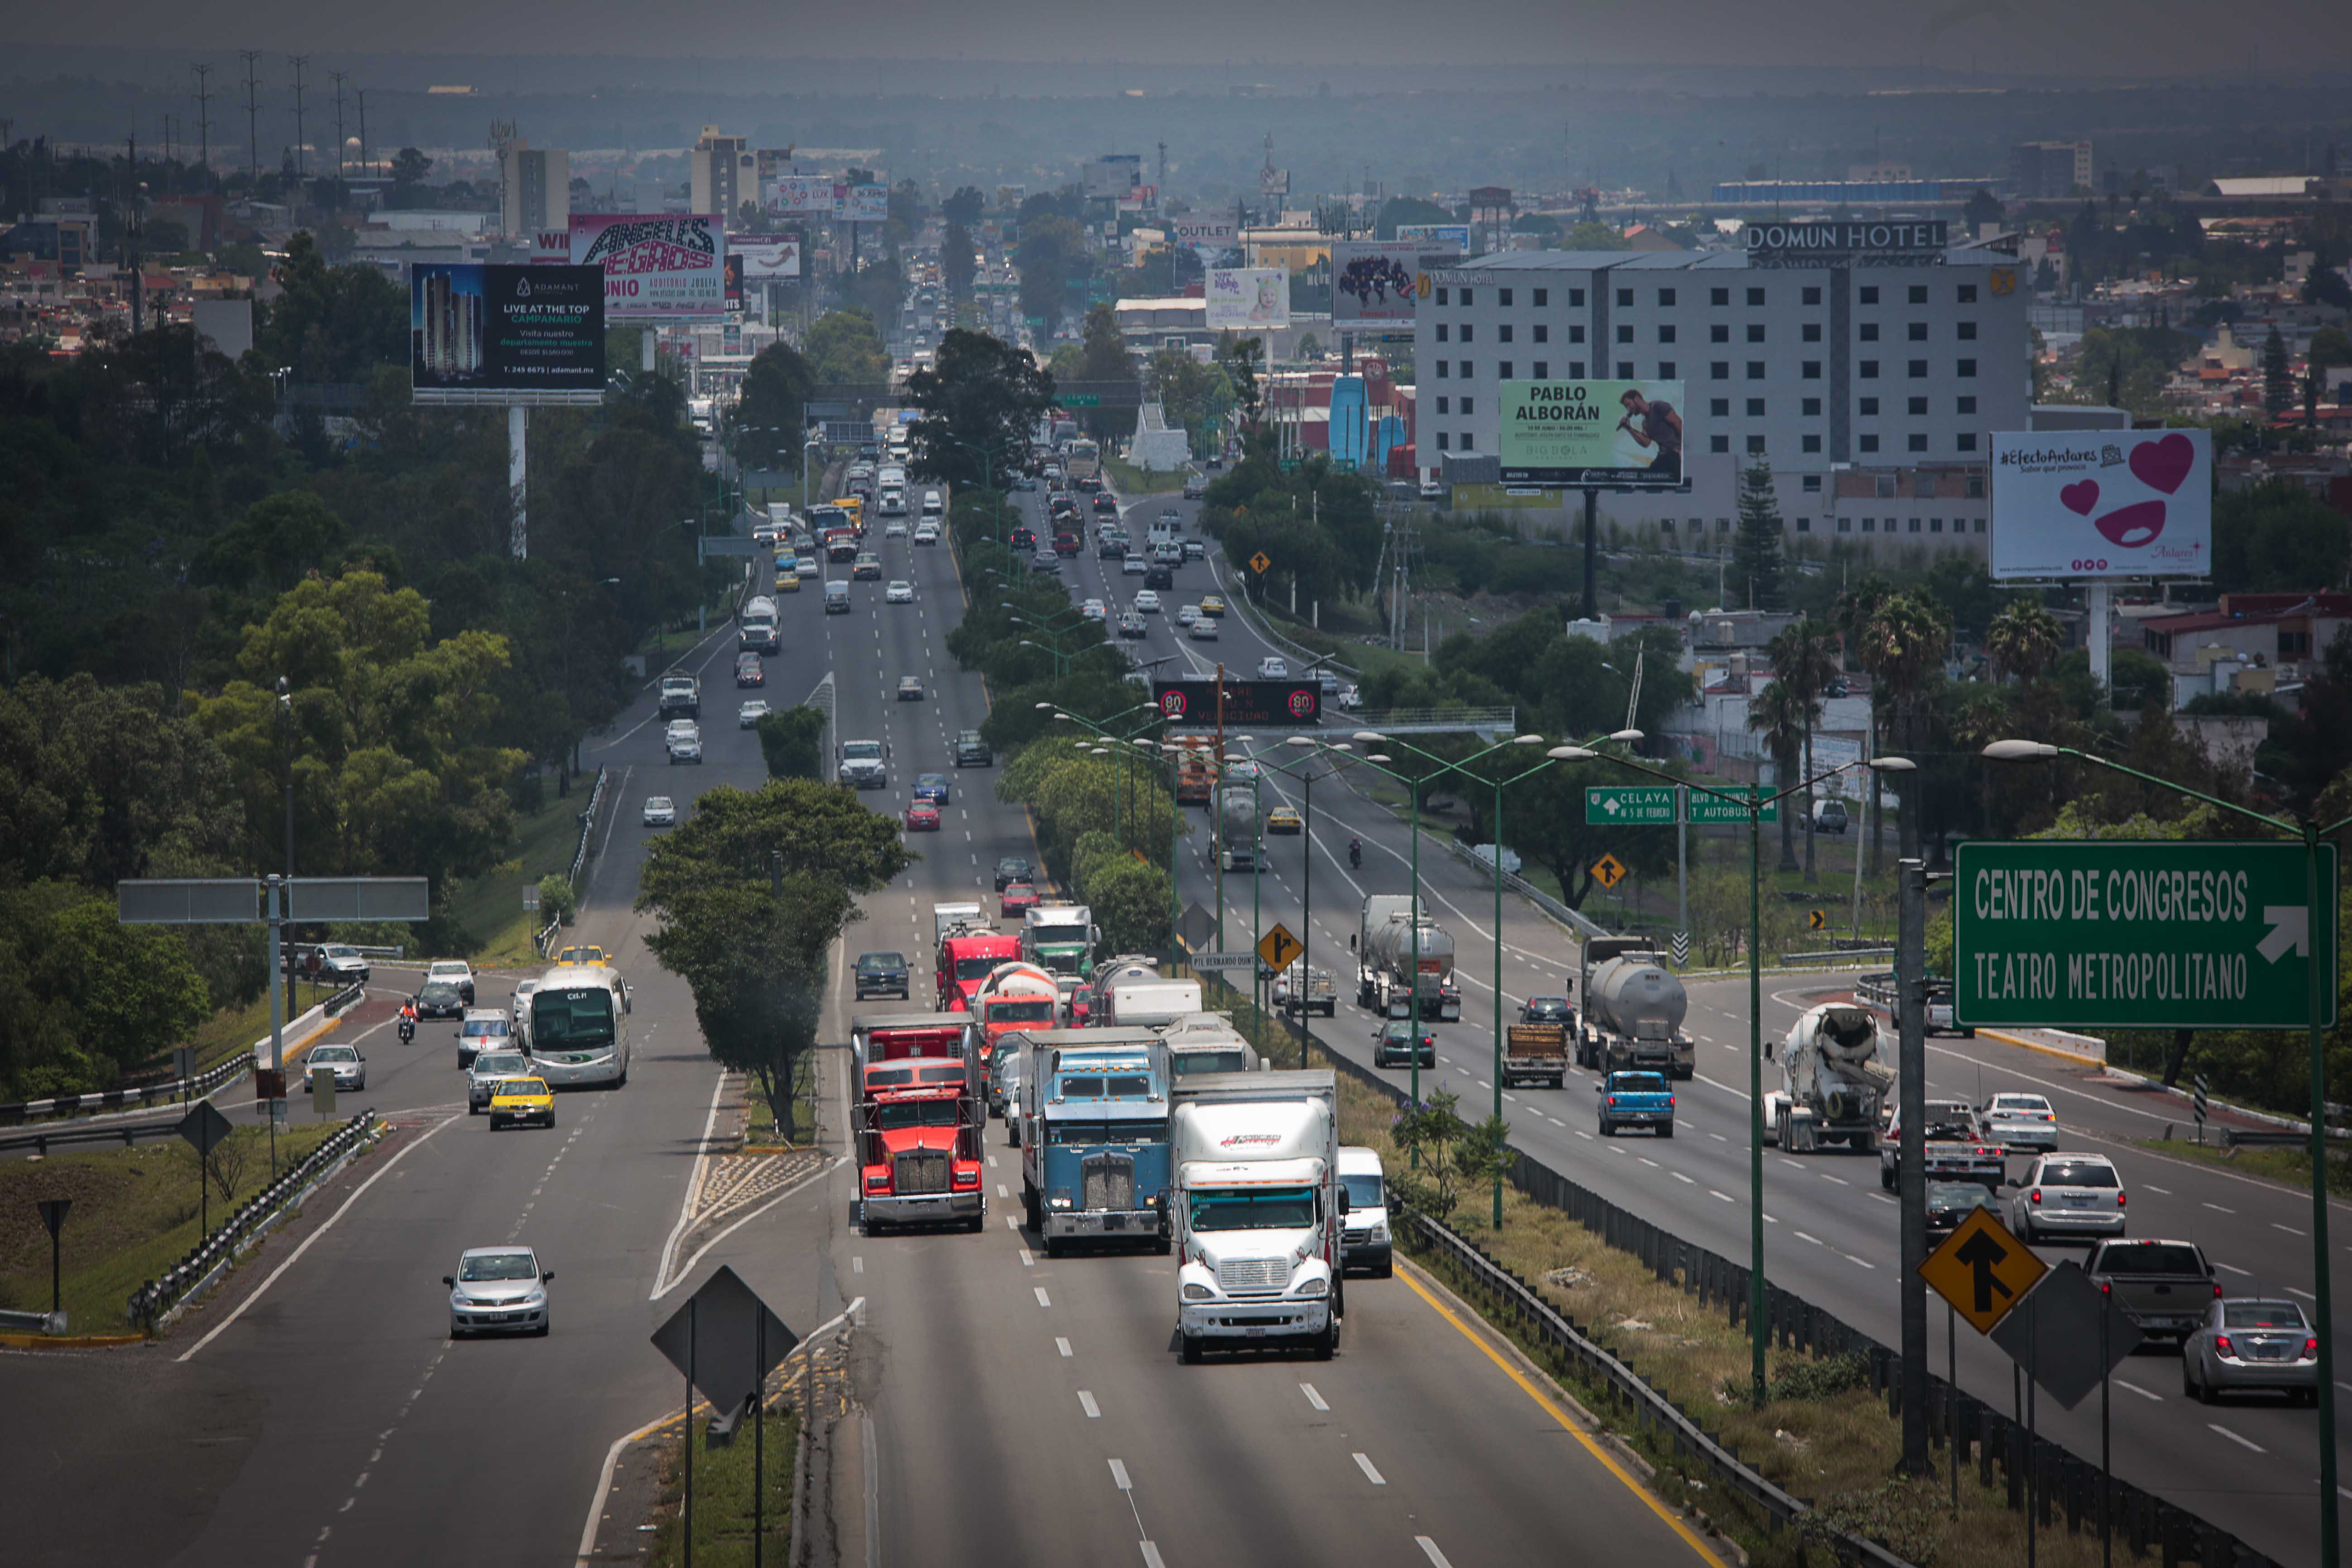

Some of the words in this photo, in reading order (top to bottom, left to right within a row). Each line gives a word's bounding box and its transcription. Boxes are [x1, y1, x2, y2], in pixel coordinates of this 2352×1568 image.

[1179, 226, 1232, 236] OUTLET
[1747, 226, 1836, 248] DOMUN
[1848, 225, 1945, 247] HOTEL
[583, 218, 715, 264] ANGELES
[649, 277, 687, 288] AUDITORIO
[691, 277, 717, 287] JOSEFA
[1431, 271, 1467, 283] DOMUN
[1471, 275, 1494, 284] HOTEL
[503, 304, 527, 313] LIVE
[529, 304, 543, 313] AT
[546, 304, 565, 313] THE
[568, 304, 589, 313] TOP
[511, 315, 582, 323] CAMPANARIO
[500, 339, 558, 347] departamento
[1530, 386, 1586, 401] PABLO
[1515, 402, 1600, 420] ALBORÁN
[1526, 445, 1549, 455] BIG
[2000, 447, 2098, 466] #EfectoAntares
[2019, 464, 2041, 473] Sabor
[2058, 464, 2086, 473] provoca
[2151, 545, 2194, 559] Antares
[1165, 695, 1181, 708] 80
[1293, 695, 1309, 708] 80
[1620, 793, 1670, 803] CELAYA
[1691, 793, 1709, 803] BLVD
[1630, 807, 1634, 817] 5
[1646, 806, 1670, 817] FEBRERO
[1692, 807, 1701, 817] T
[1975, 868, 2064, 920] CENTRO
[2071, 870, 2099, 920] DE
[2107, 870, 2248, 922] CONGRESOS
[1206, 956, 1236, 967] BERNARDO
[1974, 952, 2056, 999] TEATRO
[2068, 952, 2247, 1000] METROPOLITANO
